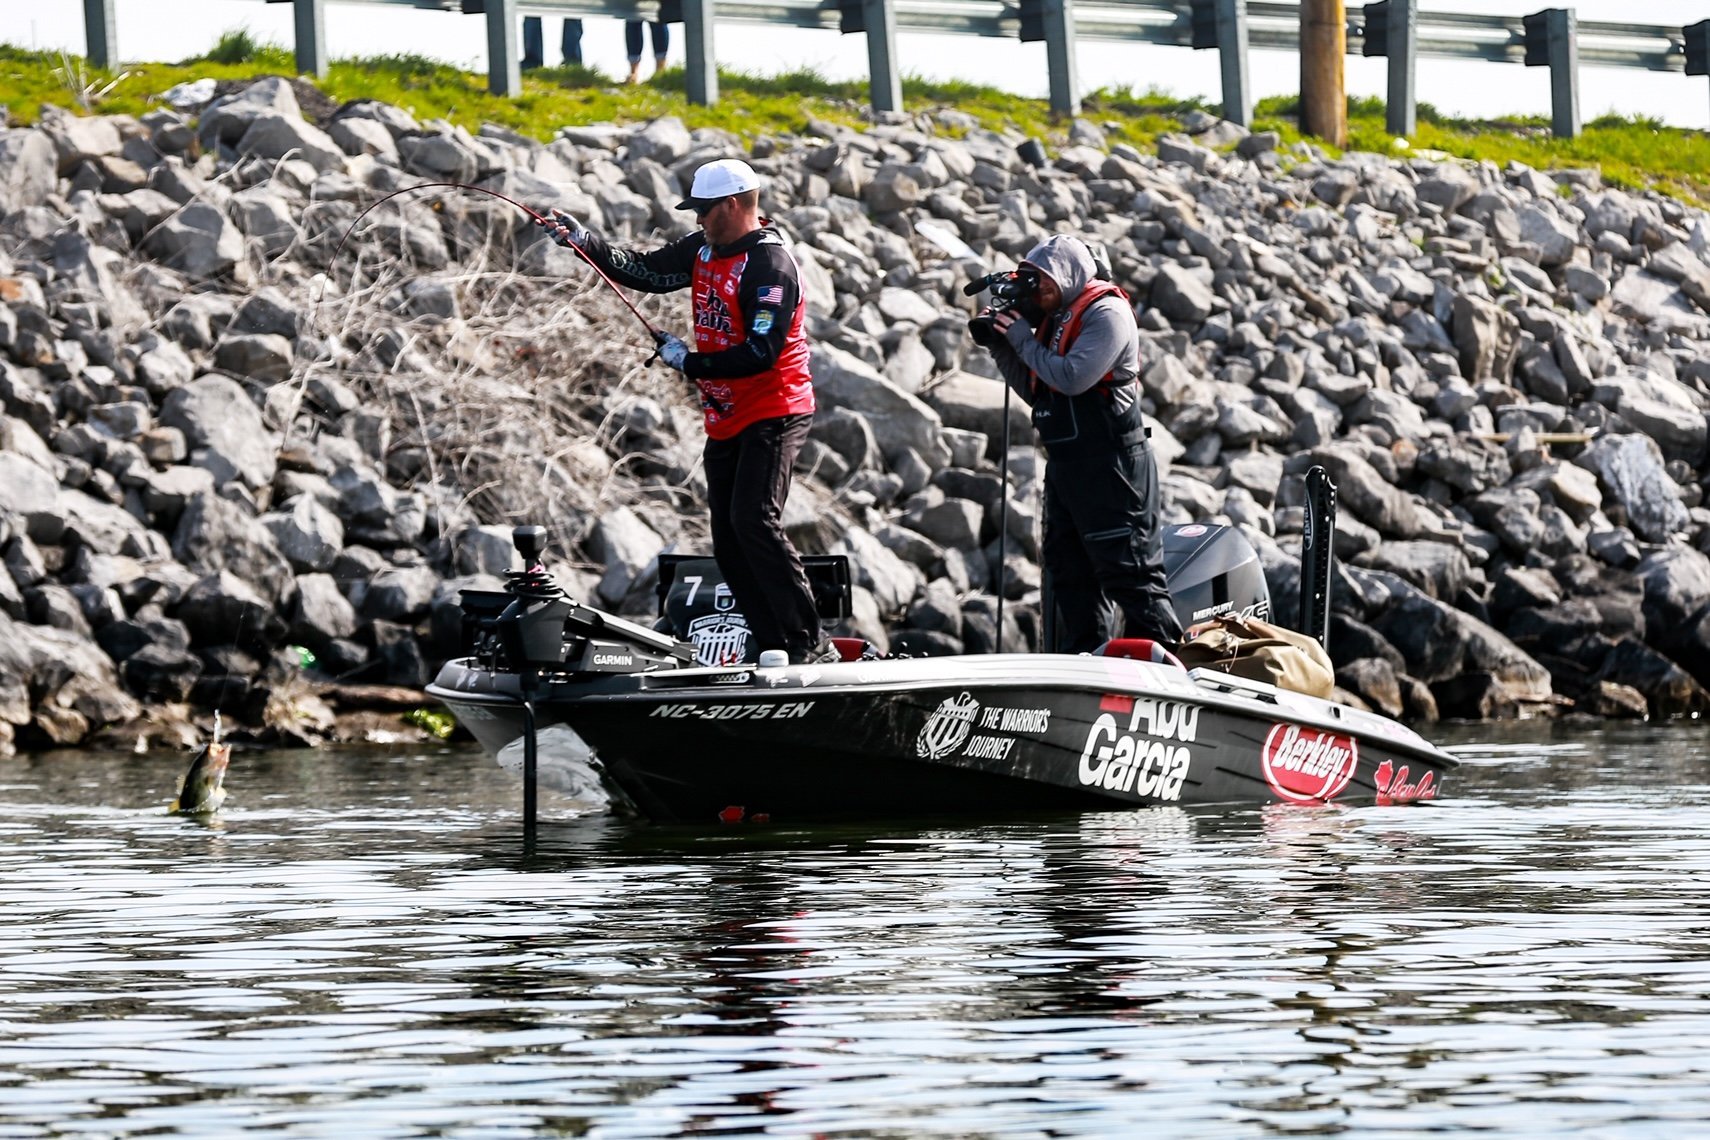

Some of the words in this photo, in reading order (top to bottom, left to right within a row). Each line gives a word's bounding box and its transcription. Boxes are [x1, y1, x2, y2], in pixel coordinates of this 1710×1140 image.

[683, 575, 703, 607] 7
[1193, 601, 1234, 621] MERCURY
[593, 654, 633, 666] GARMIN
[649, 703, 776, 720] NC-3075
[771, 701, 816, 719] EN
[978, 707, 1003, 730] THE
[1000, 708, 1051, 733] WARRIOR'S
[962, 735, 1016, 760] JOURNEY
[1078, 713, 1191, 801] Garcia
[1270, 724, 1351, 783] Berkley
